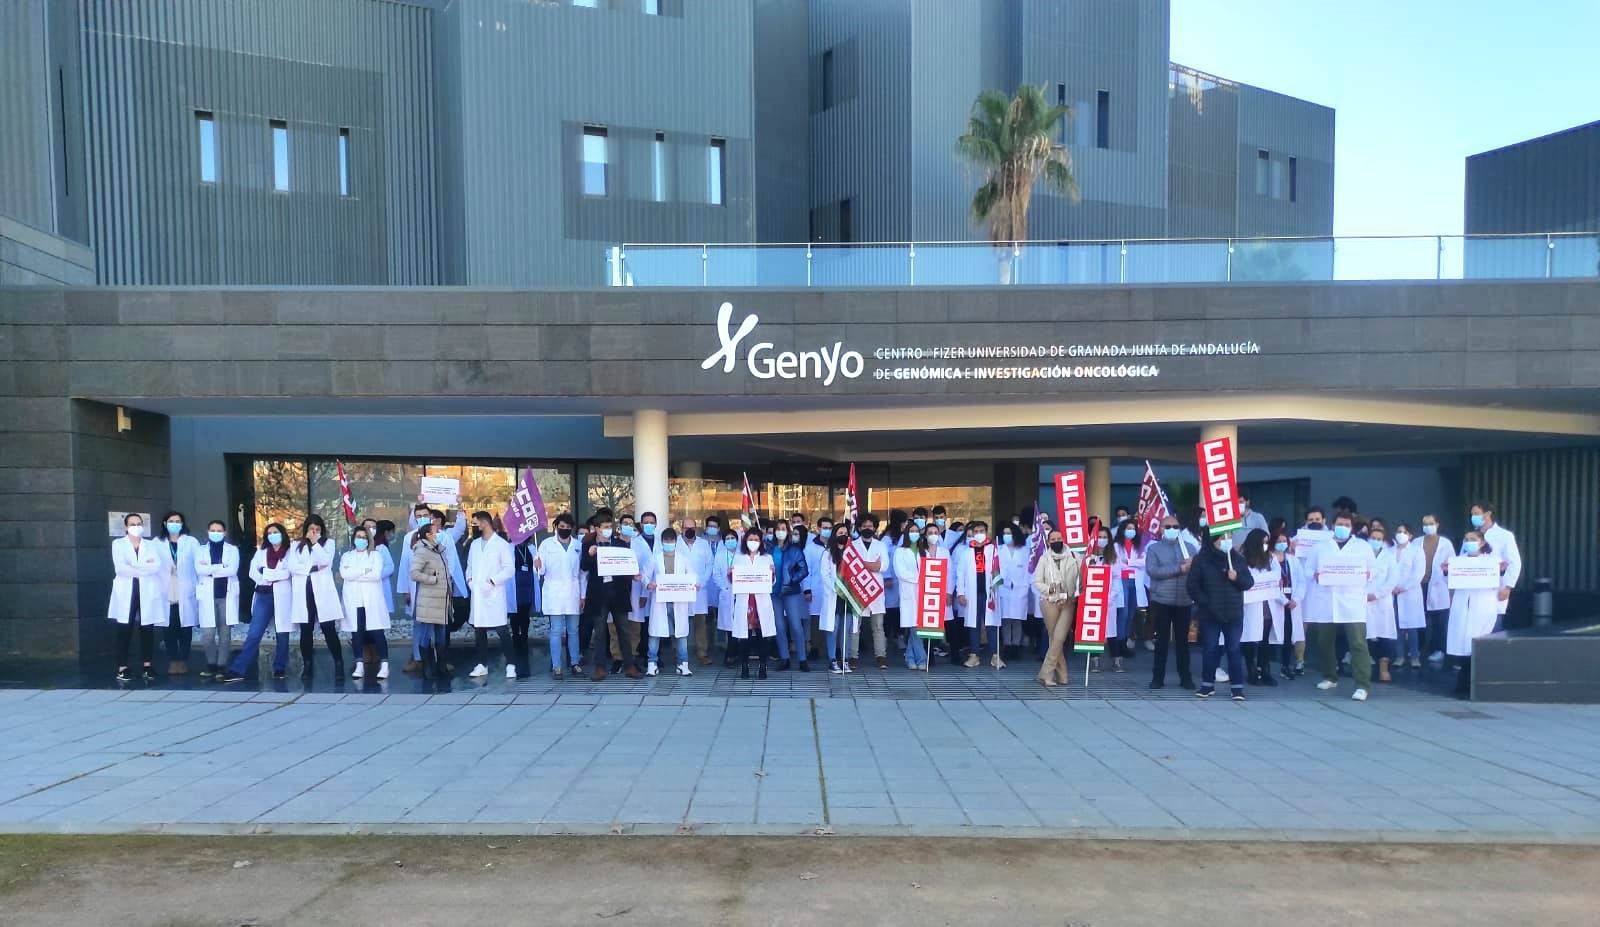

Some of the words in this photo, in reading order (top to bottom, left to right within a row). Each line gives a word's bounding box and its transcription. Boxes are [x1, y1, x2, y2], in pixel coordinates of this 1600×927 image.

[875, 368, 891, 380] DE
[893, 365, 962, 380] GENÓMICA
[965, 368, 971, 379] E
[973, 364, 1071, 379] INVESTIGACIÓN
[1074, 364, 1159, 378] ONCOLÓGICA
[876, 347, 923, 360] CENTRO
[927, 346, 965, 359] FIZER
[968, 345, 1046, 358] UNIVERSIDAD
[1050, 345, 1065, 357] DE
[1068, 345, 1127, 357] GRANADA
[1131, 343, 1168, 356] JUNTA
[1171, 343, 1186, 355] DE
[1189, 340, 1260, 355] ANDALUCÍA
[1061, 473, 1084, 544] CCOO
[1203, 440, 1235, 523] CCOO
[842, 545, 881, 598] CCOO
[922, 559, 942, 628] CCOO
[1080, 567, 1105, 641] CCOO
